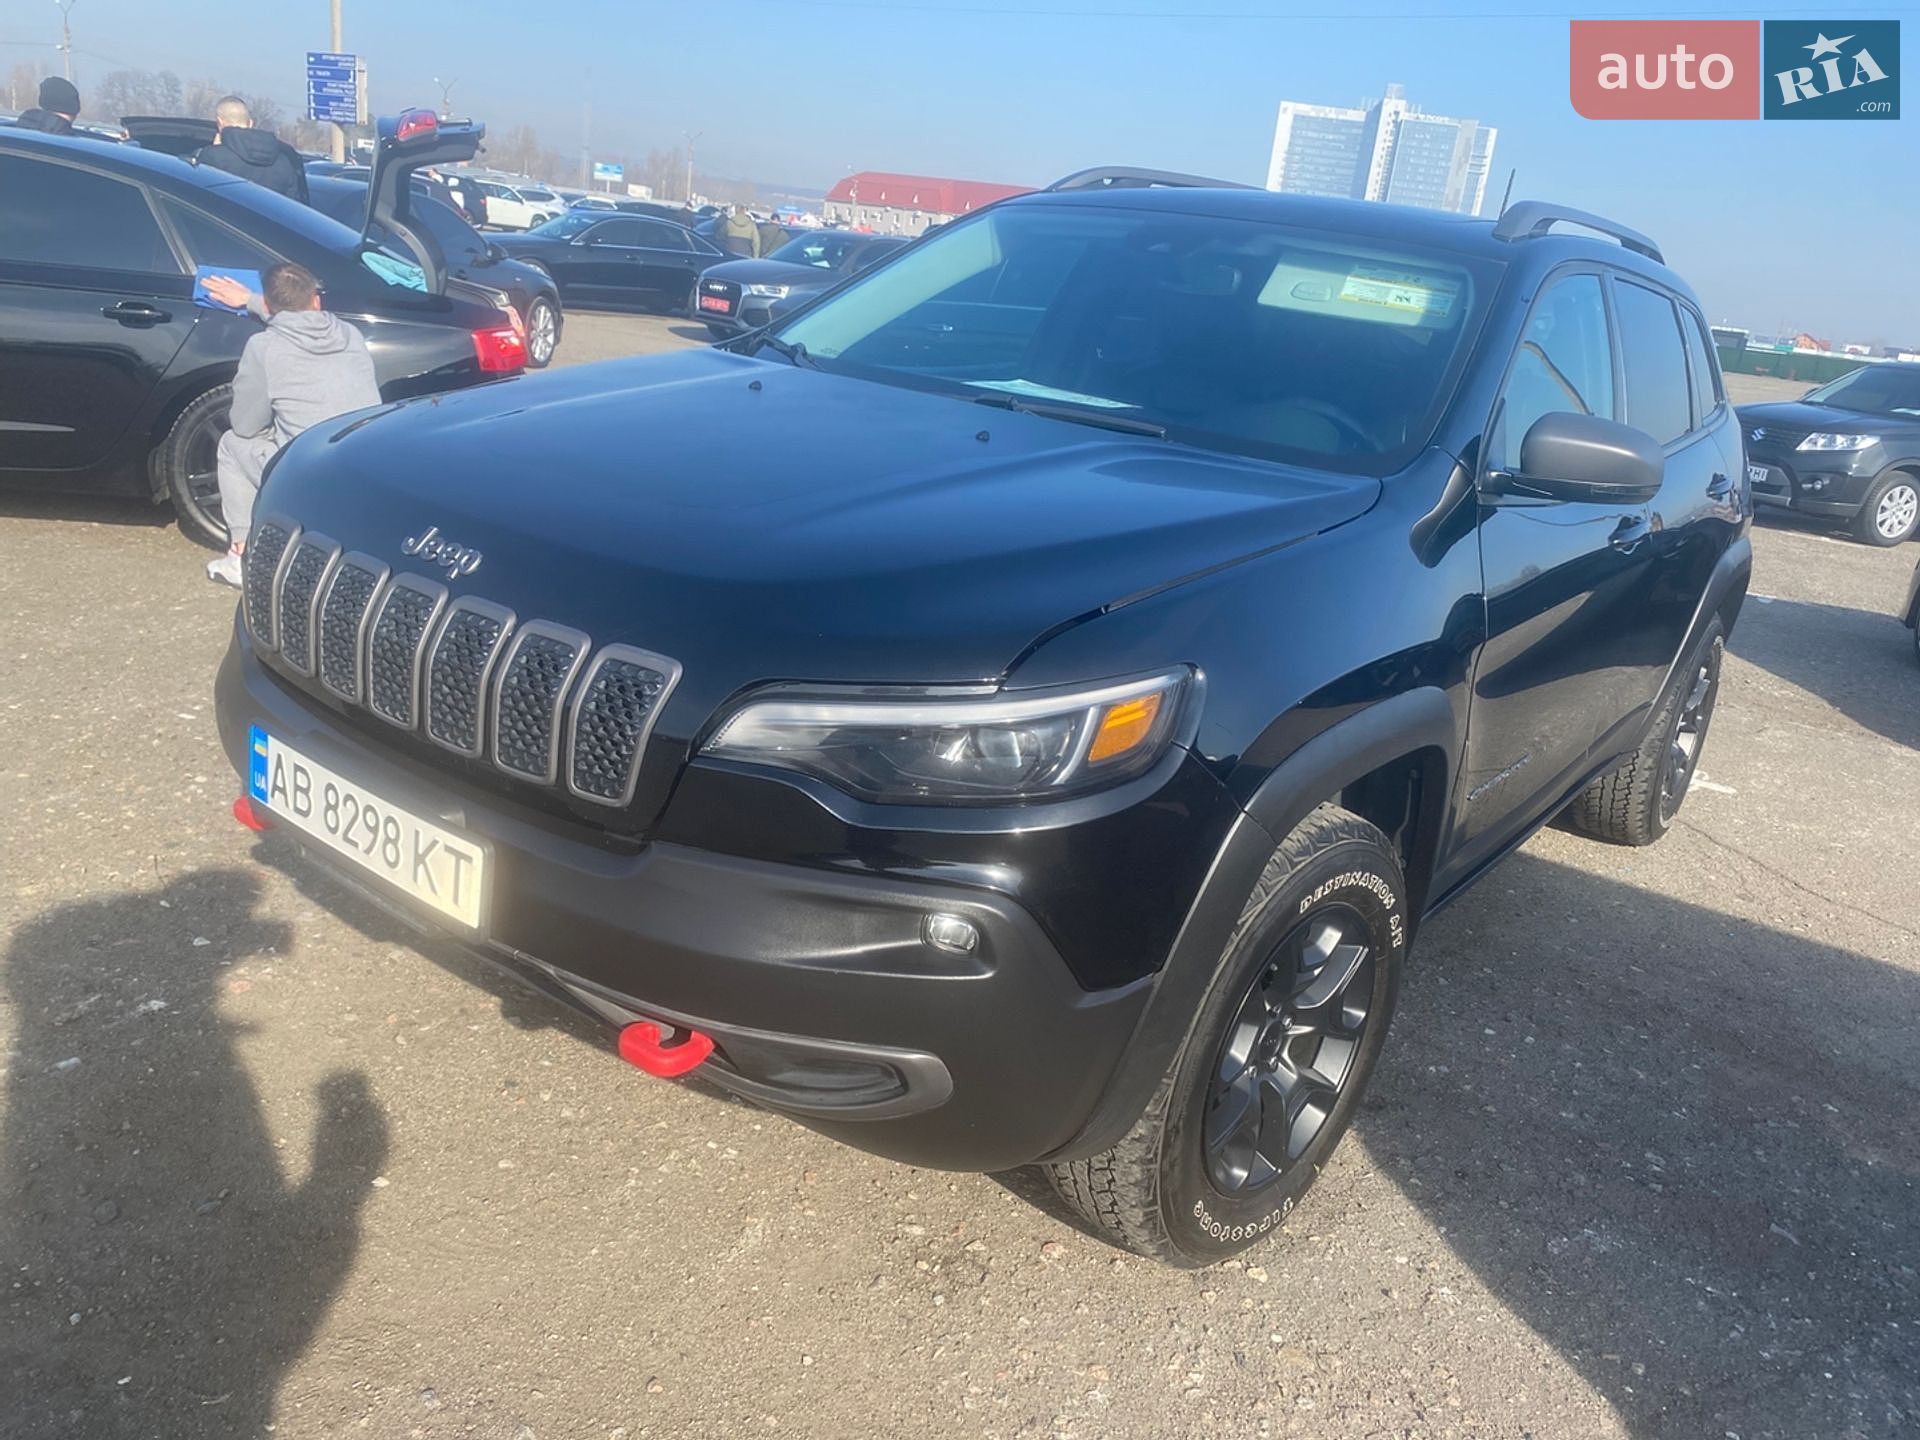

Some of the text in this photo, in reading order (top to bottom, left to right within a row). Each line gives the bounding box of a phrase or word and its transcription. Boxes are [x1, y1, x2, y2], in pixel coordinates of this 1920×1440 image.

[401, 526, 483, 579] Jeep
[254, 772, 267, 790] UA
[271, 752, 473, 908] AB 8298 KT
[1299, 870, 1396, 914] DESTINATION
